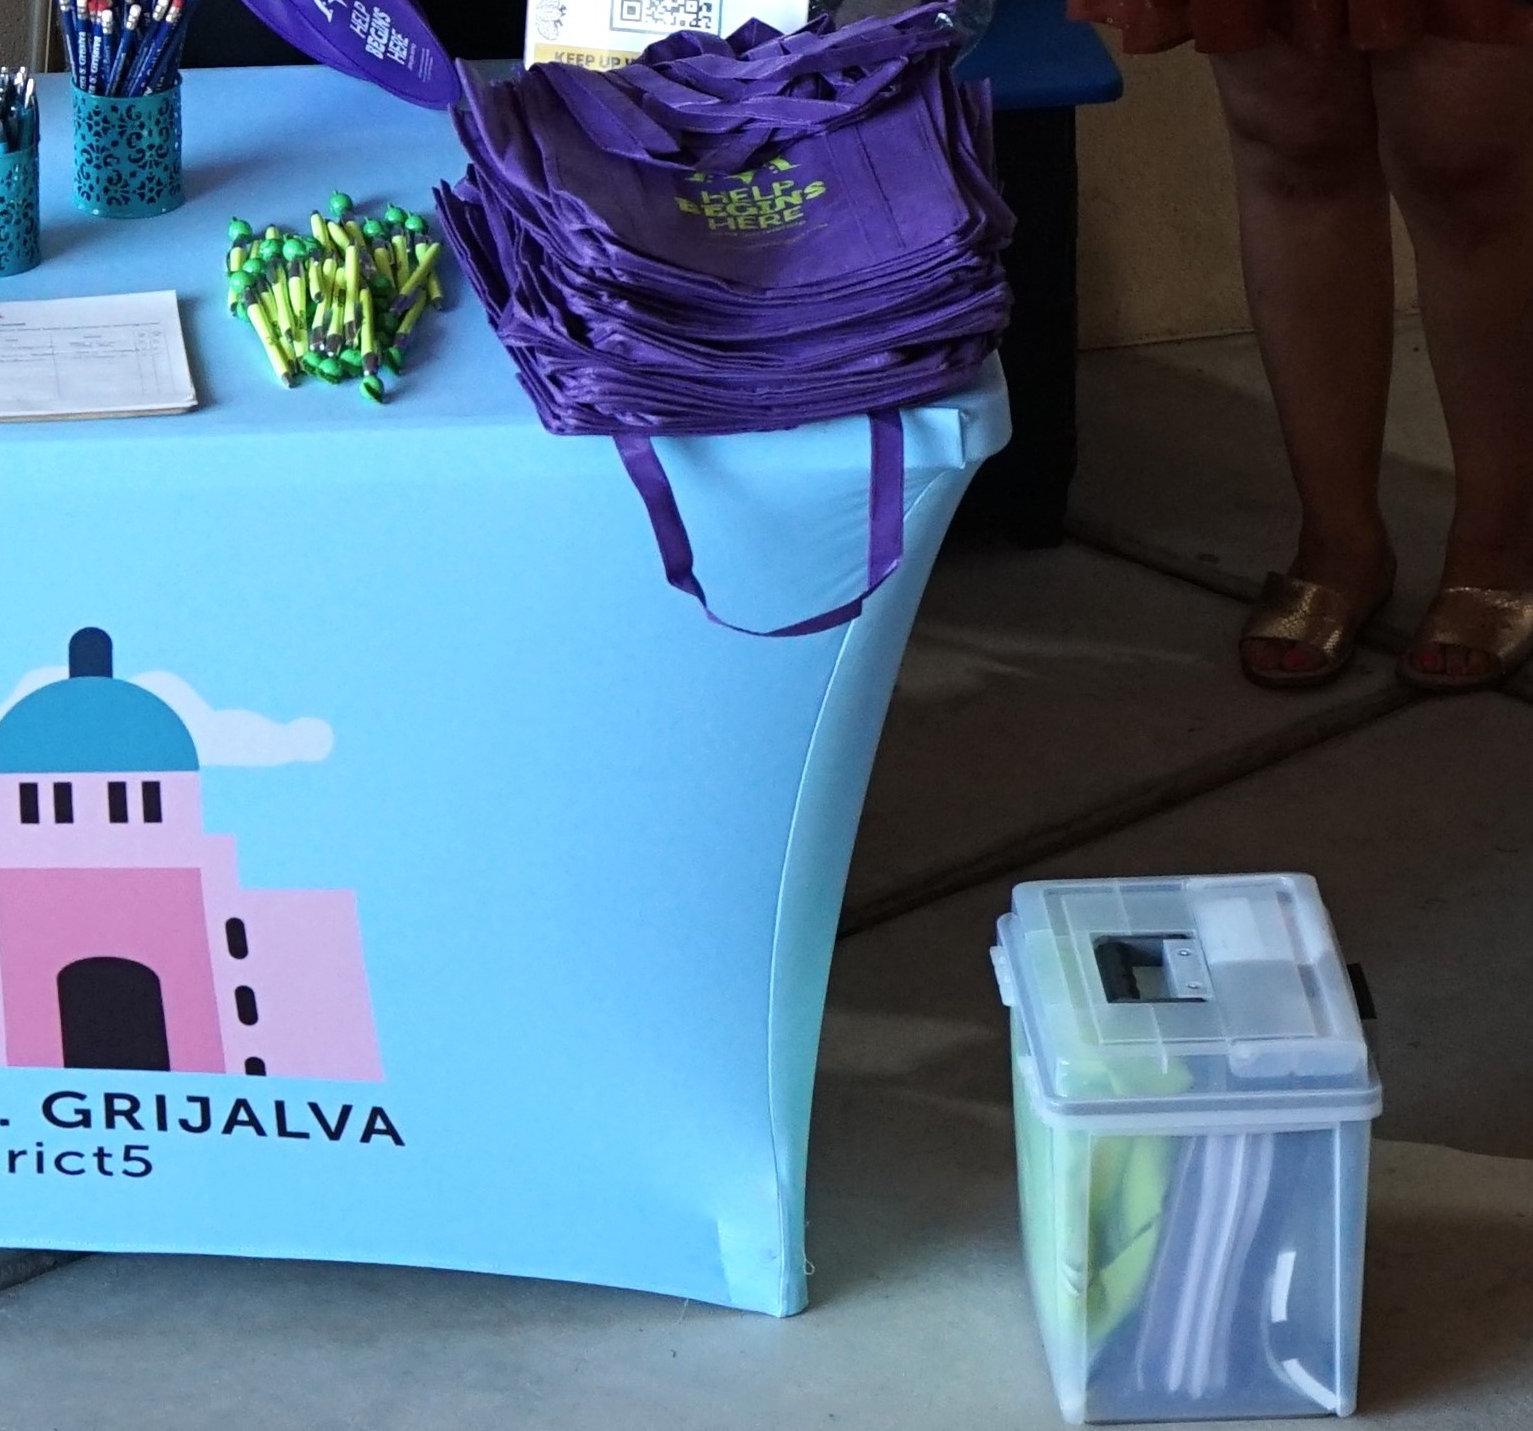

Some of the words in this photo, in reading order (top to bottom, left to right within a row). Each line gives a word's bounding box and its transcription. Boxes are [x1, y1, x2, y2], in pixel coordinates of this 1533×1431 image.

[349, 0, 371, 39] HELP
[364, 6, 392, 60] BEGINS
[386, 28, 410, 66] HERE
[554, 51, 596, 68] KEEP
[599, 55, 621, 69] UP
[674, 180, 826, 217] BEGINS
[700, 180, 794, 204] HELP
[707, 205, 805, 230] HERE
[40, 1089, 407, 1147] GRIJALVA
